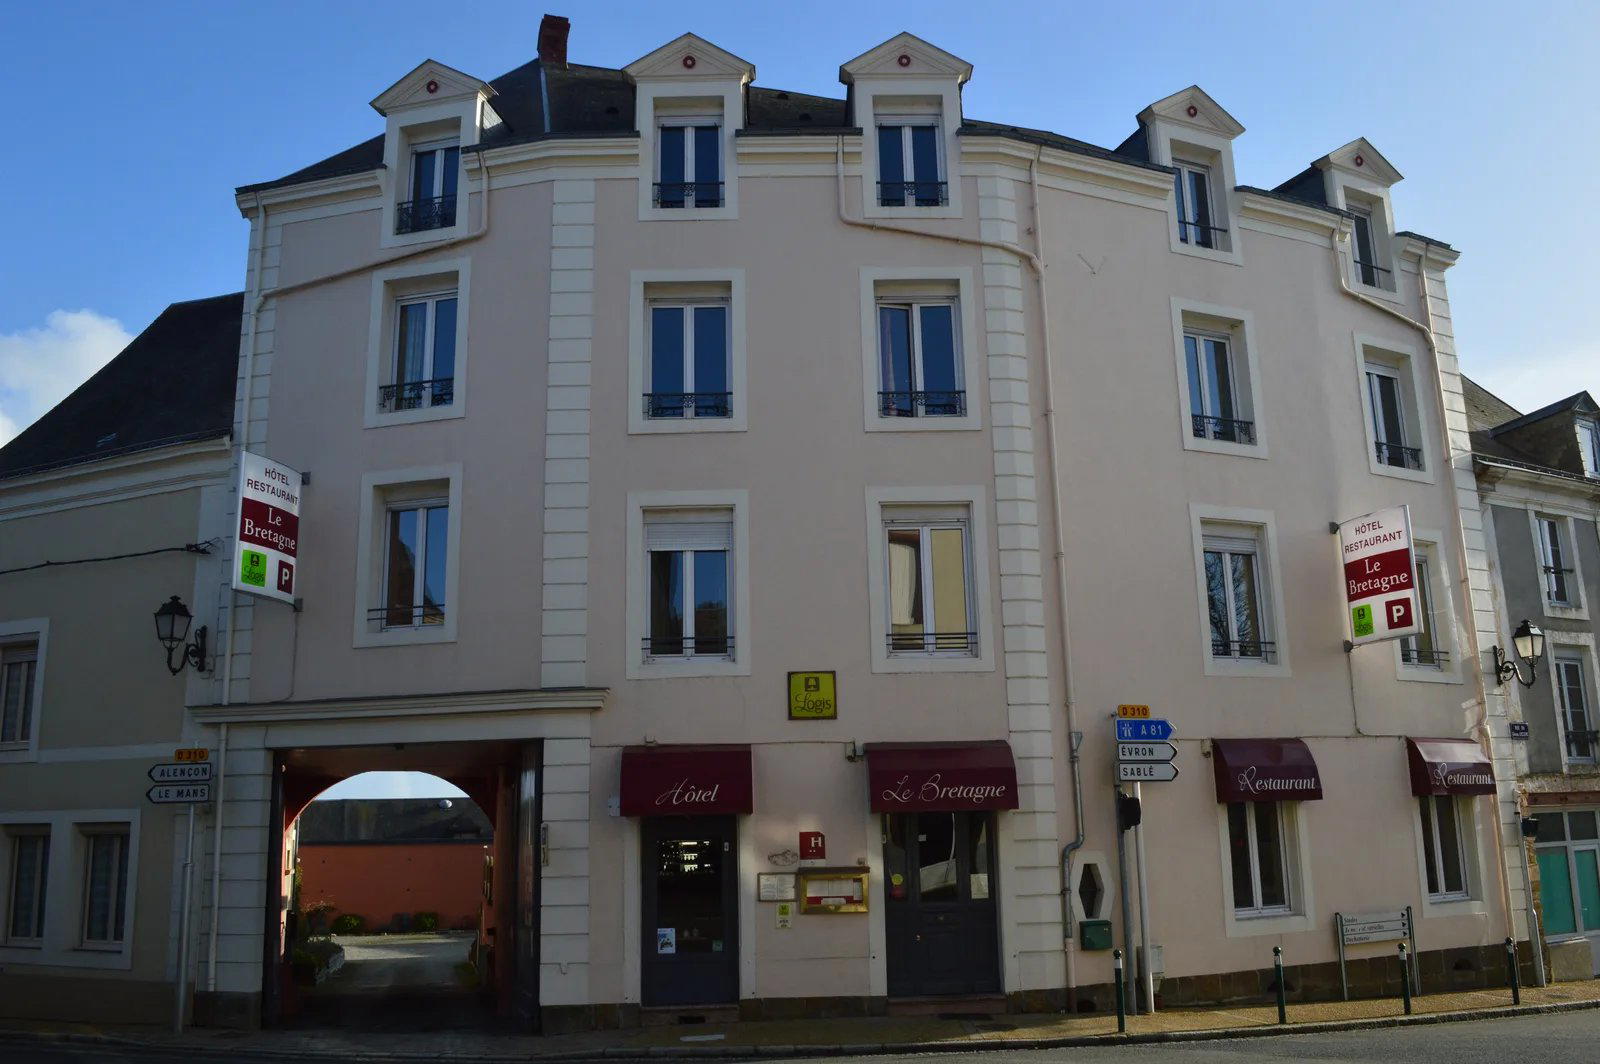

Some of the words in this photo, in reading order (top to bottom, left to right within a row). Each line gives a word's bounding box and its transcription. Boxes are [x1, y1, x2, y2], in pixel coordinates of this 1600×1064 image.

[265, 467, 290, 486] HÔTEL
[247, 478, 298, 506] RESTAURANT
[268, 507, 282, 526] Le
[244, 517, 296, 550] Bretagne
[1354, 520, 1384, 536] HÔTEL
[1344, 530, 1403, 554] RESTAURANT
[1364, 558, 1381, 574] Le
[281, 567, 290, 586] P
[1348, 572, 1409, 595] Bretagne
[1392, 605, 1405, 623] P
[794, 692, 832, 714] Logis
[1122, 706, 1128, 716] D
[1130, 706, 1148, 716] 310
[1141, 724, 1147, 736] A
[1150, 724, 1163, 736] 81
[1121, 745, 1154, 757] ÉVRON
[160, 767, 208, 778] ALENÇON
[1122, 765, 1154, 777] SABLÉ
[1237, 765, 1316, 795] Restaurant
[1431, 762, 1492, 789] Restaurant
[158, 789, 170, 799] LE
[176, 788, 206, 799] MANS
[655, 777, 720, 806] Hôtel
[882, 775, 914, 803] Le
[919, 773, 1006, 804] Bretagne
[811, 836, 822, 848] H
